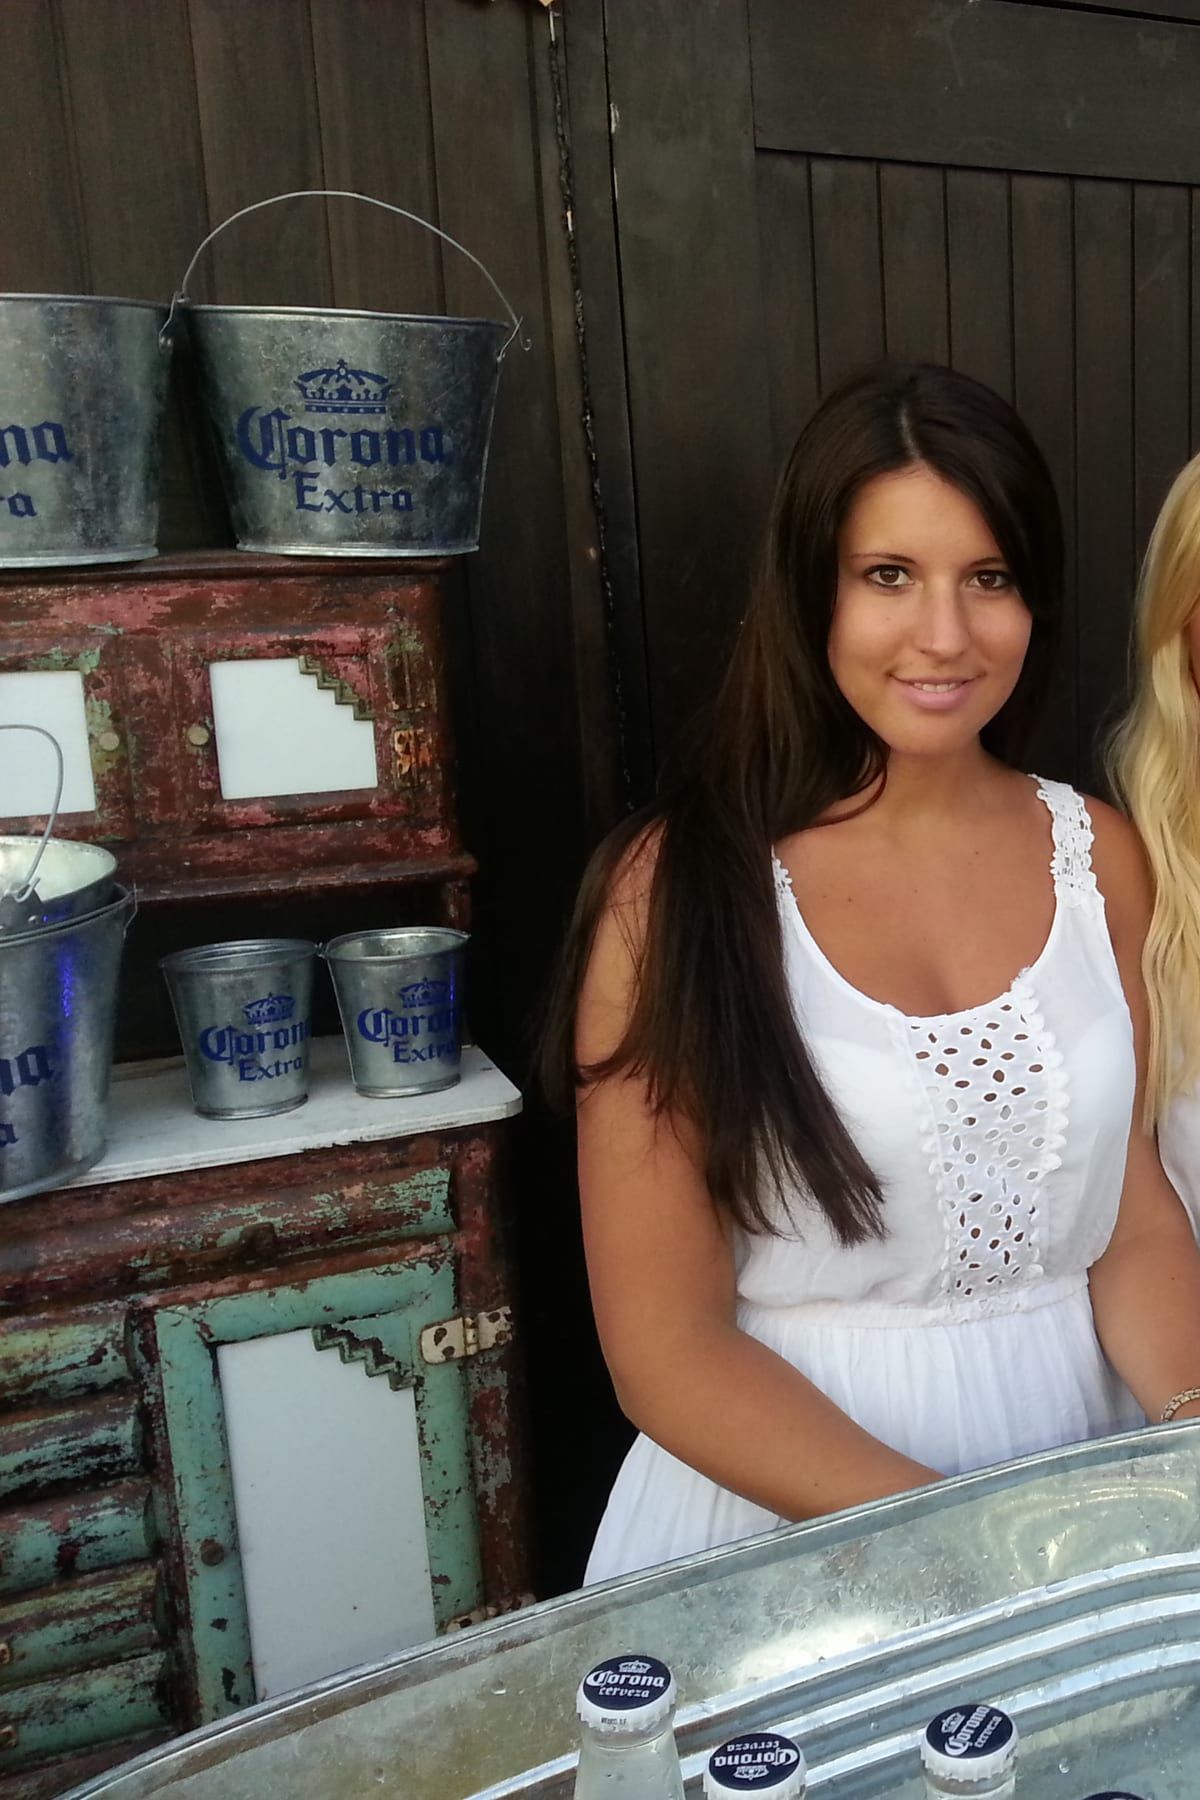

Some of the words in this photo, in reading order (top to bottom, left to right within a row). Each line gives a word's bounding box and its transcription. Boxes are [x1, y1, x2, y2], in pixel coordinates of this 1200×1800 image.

[236, 406, 447, 480] Corona
[292, 470, 413, 514] Extra
[199, 1022, 310, 1066] Coron
[239, 1057, 304, 1082] Extra
[585, 1669, 666, 1688] Corona
[598, 1686, 651, 1698] cerveza
[944, 1705, 991, 1756] Corona
[974, 1715, 1003, 1748] cerveza
[713, 1747, 799, 1767] Corona
[726, 1740, 780, 1752] cerveza
